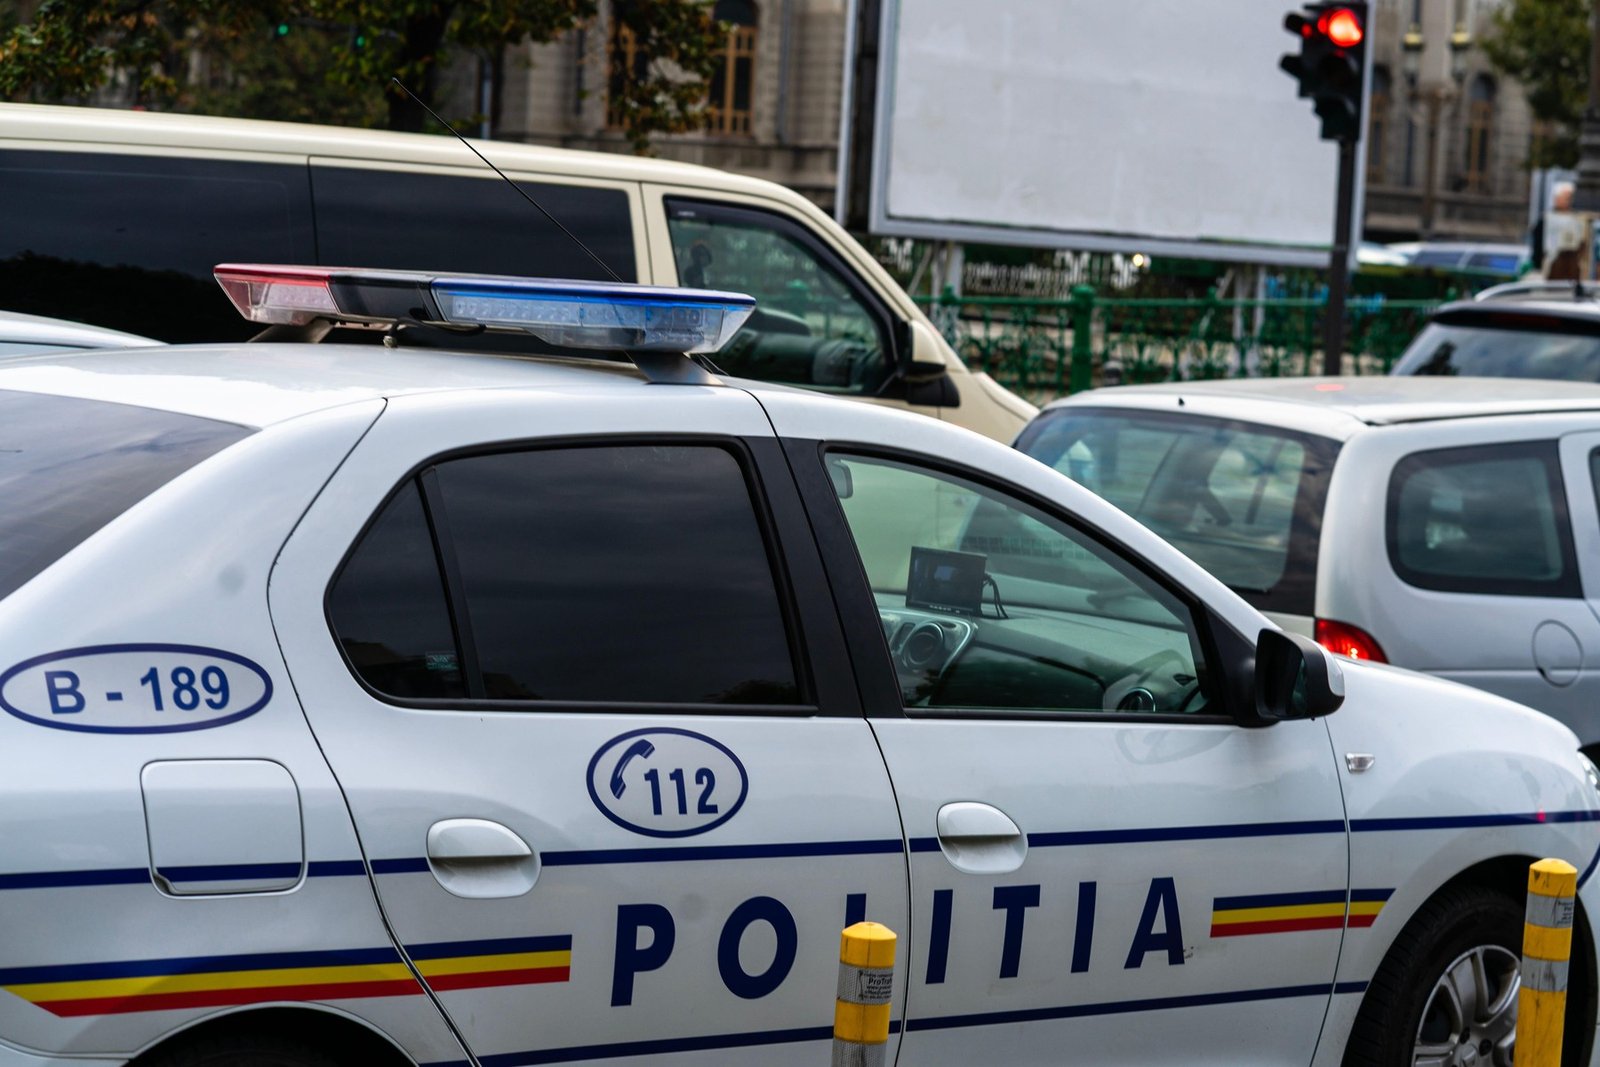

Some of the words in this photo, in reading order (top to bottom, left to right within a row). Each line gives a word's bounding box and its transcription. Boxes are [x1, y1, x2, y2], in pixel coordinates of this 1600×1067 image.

[44, 670, 86, 714] B
[140, 665, 230, 711] 189
[643, 767, 718, 815] 112
